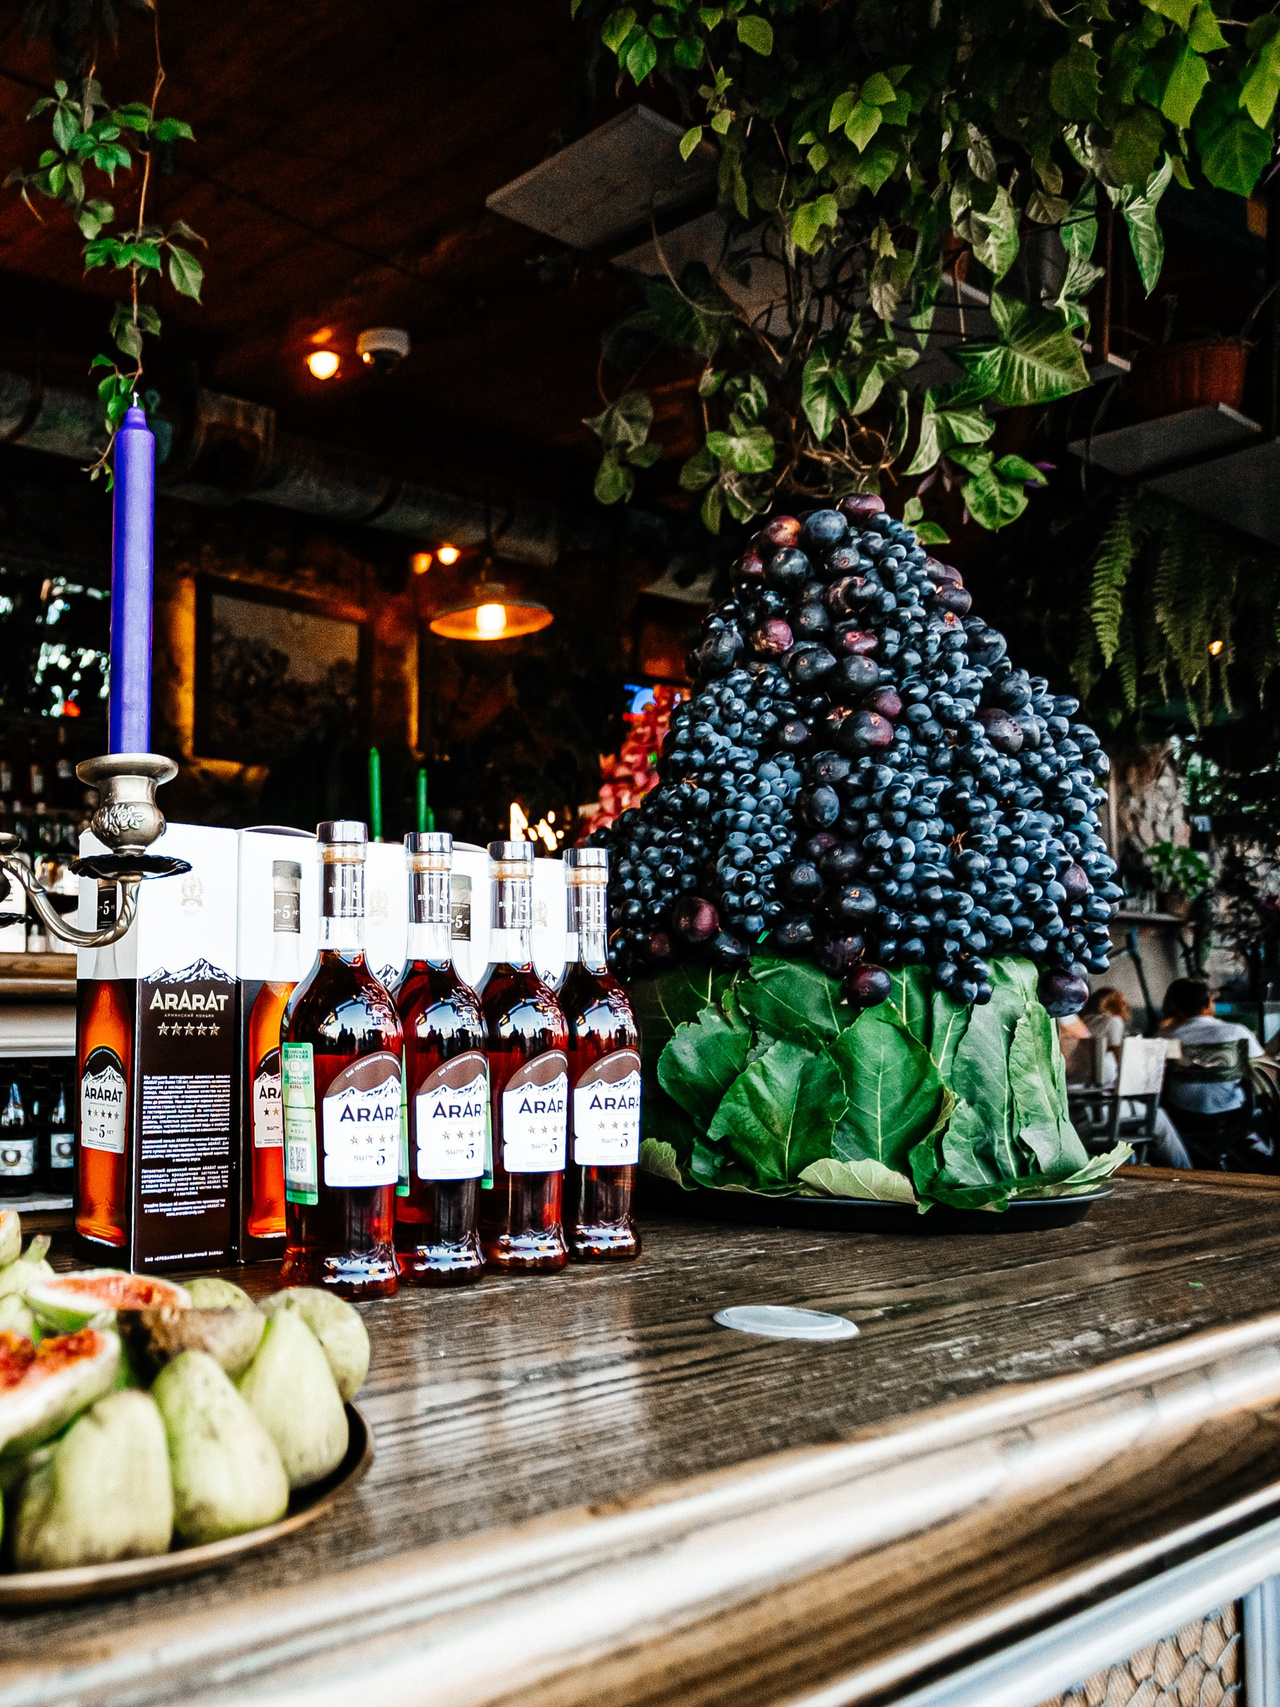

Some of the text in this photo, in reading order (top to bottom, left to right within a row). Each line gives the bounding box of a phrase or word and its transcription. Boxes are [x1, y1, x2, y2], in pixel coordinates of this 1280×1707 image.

[102, 900, 110, 915] 5
[282, 904, 291, 919] 5
[454, 914, 463, 929] 5
[149, 988, 229, 1011] ARARAT
[84, 1085, 123, 1103] ARARAT
[99, 1124, 106, 1138] 5
[549, 1137, 558, 1154] 5
[620, 1132, 629, 1148] 5
[376, 1148, 386, 1166] 5
[466, 1143, 475, 1160] 5
